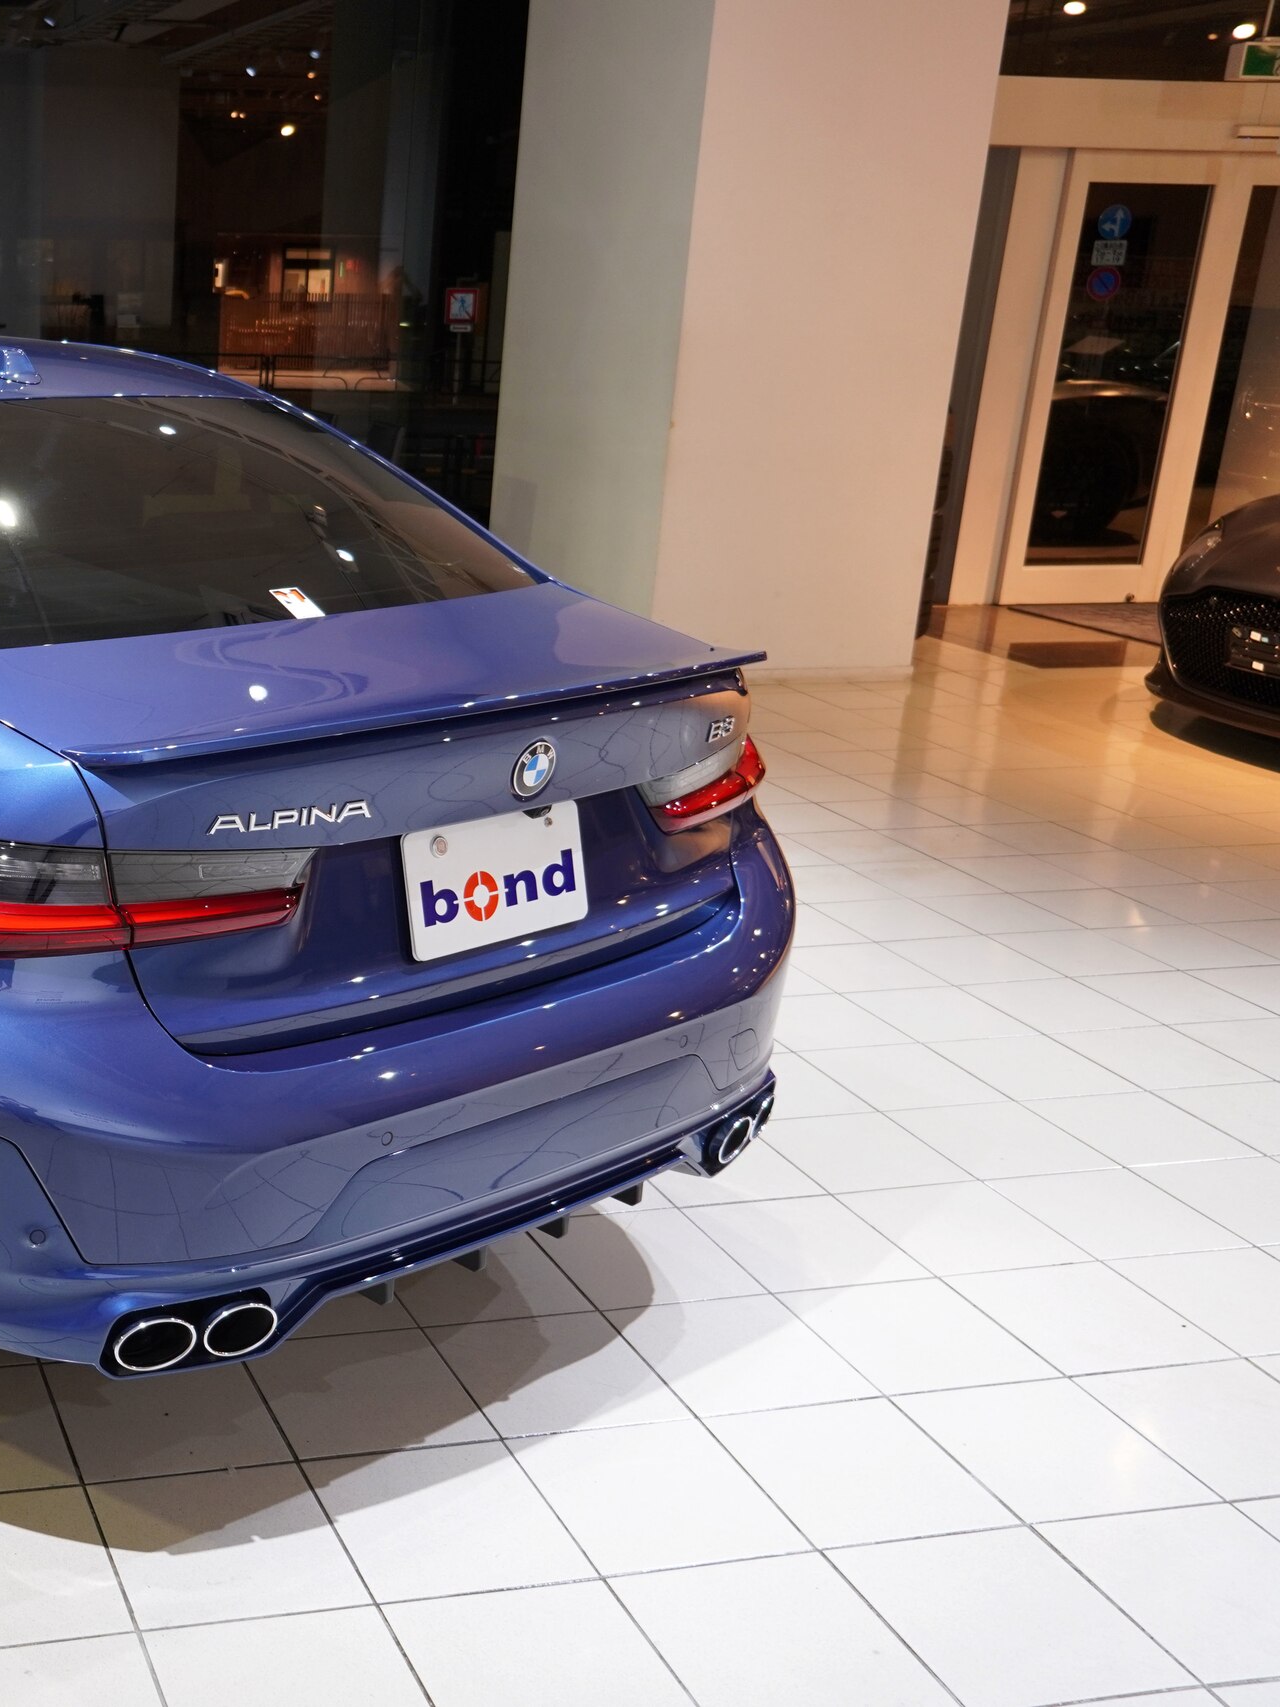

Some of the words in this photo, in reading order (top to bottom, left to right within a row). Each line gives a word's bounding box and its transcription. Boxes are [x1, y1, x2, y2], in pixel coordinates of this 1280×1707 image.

[522, 744, 554, 764] BMW
[206, 799, 372, 836] ALPINA
[420, 848, 577, 928] bond
